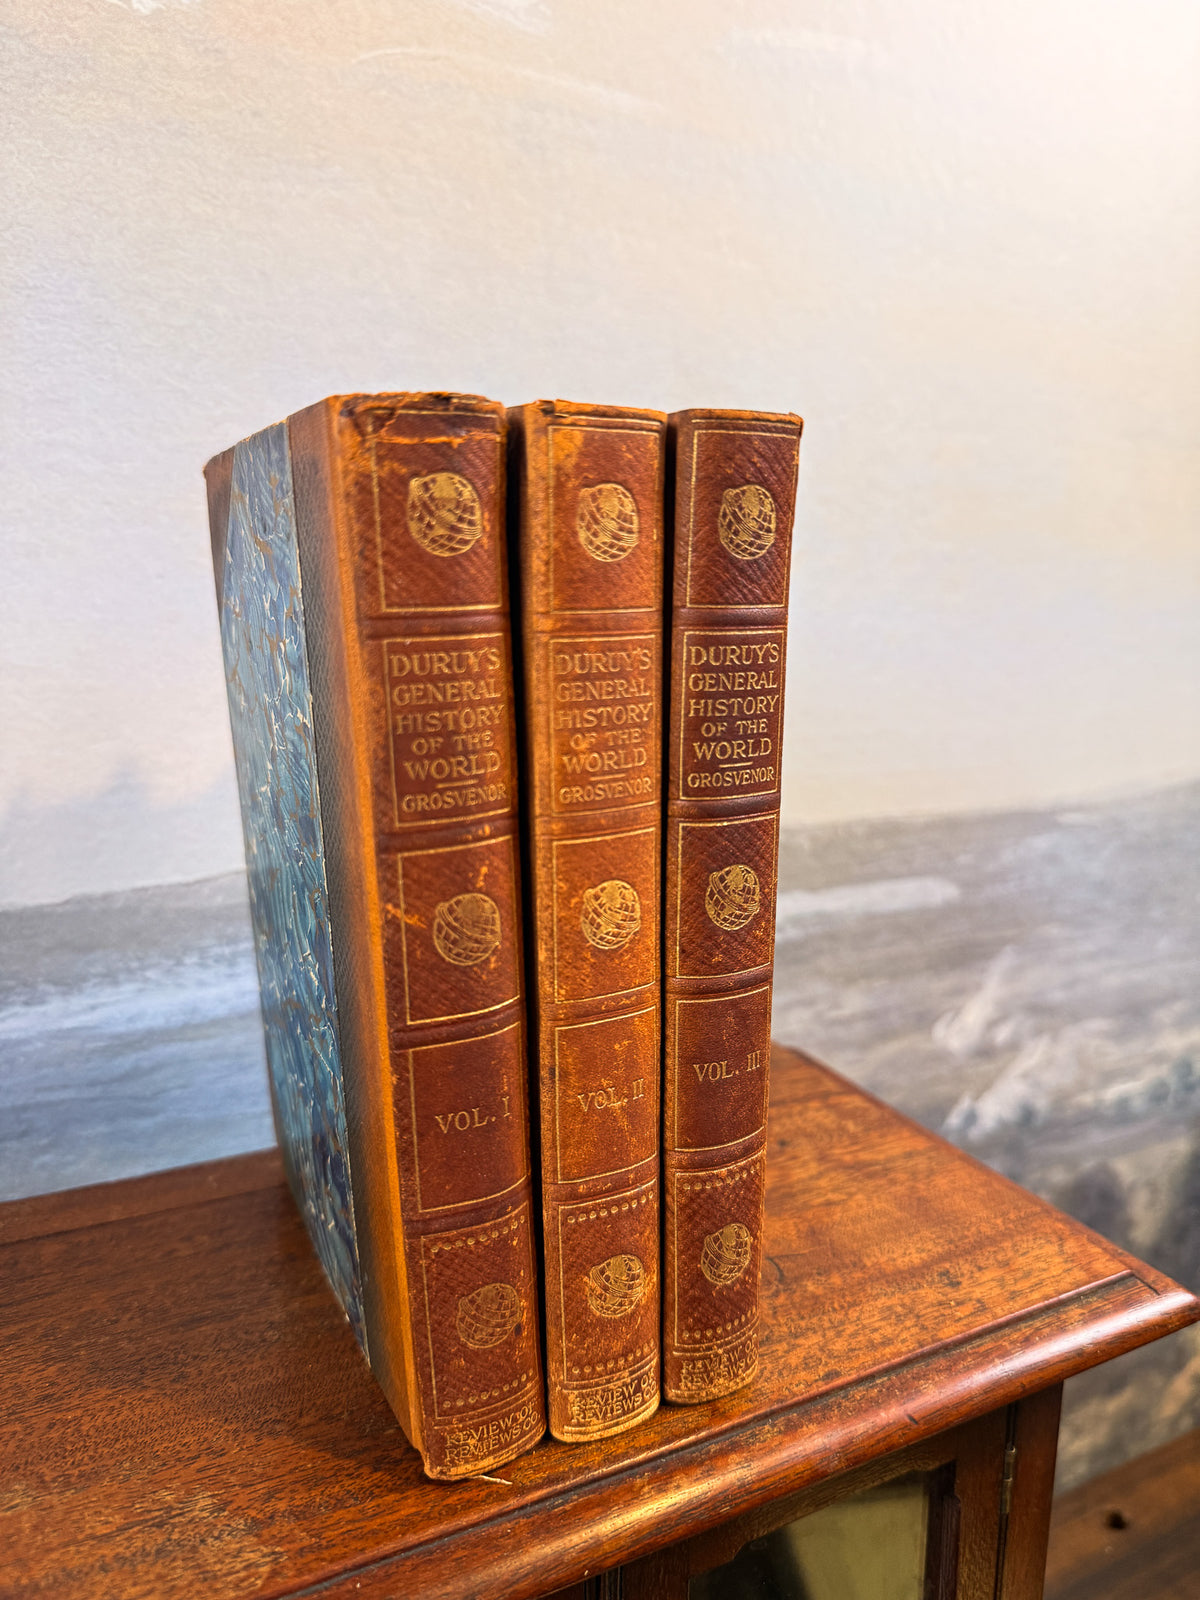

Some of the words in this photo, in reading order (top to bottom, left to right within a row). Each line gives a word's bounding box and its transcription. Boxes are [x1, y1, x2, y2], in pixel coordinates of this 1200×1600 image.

[390, 647, 500, 677] DURUY'S
[554, 648, 652, 675] DURUY'S
[688, 641, 780, 666] DURUY'S
[393, 679, 501, 706] GENERAL
[556, 678, 651, 702] GENERAL
[688, 670, 778, 692] GENERAL
[396, 704, 505, 735] HISTORY
[555, 703, 653, 729] HISTORY
[688, 695, 779, 717] HISTORY
[570, 732, 597, 750] OF
[606, 728, 642, 746] THE
[701, 722, 728, 737] OF
[735, 718, 768, 735] THE
[412, 737, 444, 755] OF
[453, 730, 494, 752] THE
[692, 738, 772, 761] WORLD
[403, 750, 500, 781] WORLD
[562, 748, 647, 774] WORLD
[559, 777, 652, 804] GROSVENOR
[687, 766, 775, 788] GROSVENOR
[402, 783, 507, 813] GROSVENOR
[693, 1059, 740, 1082] VOL.
[746, 1050, 761, 1072] III
[577, 1087, 628, 1112] VOL.
[632, 1078, 645, 1100] II
[434, 1107, 496, 1134] VOL.
[501, 1096, 510, 1118] I
[573, 1380, 638, 1408] REVIEW
[641, 1368, 655, 1387] OF
[572, 1393, 642, 1422] REVIEWS
[445, 1413, 514, 1447] REVIEW
[445, 1426, 520, 1465] REVIEWS
